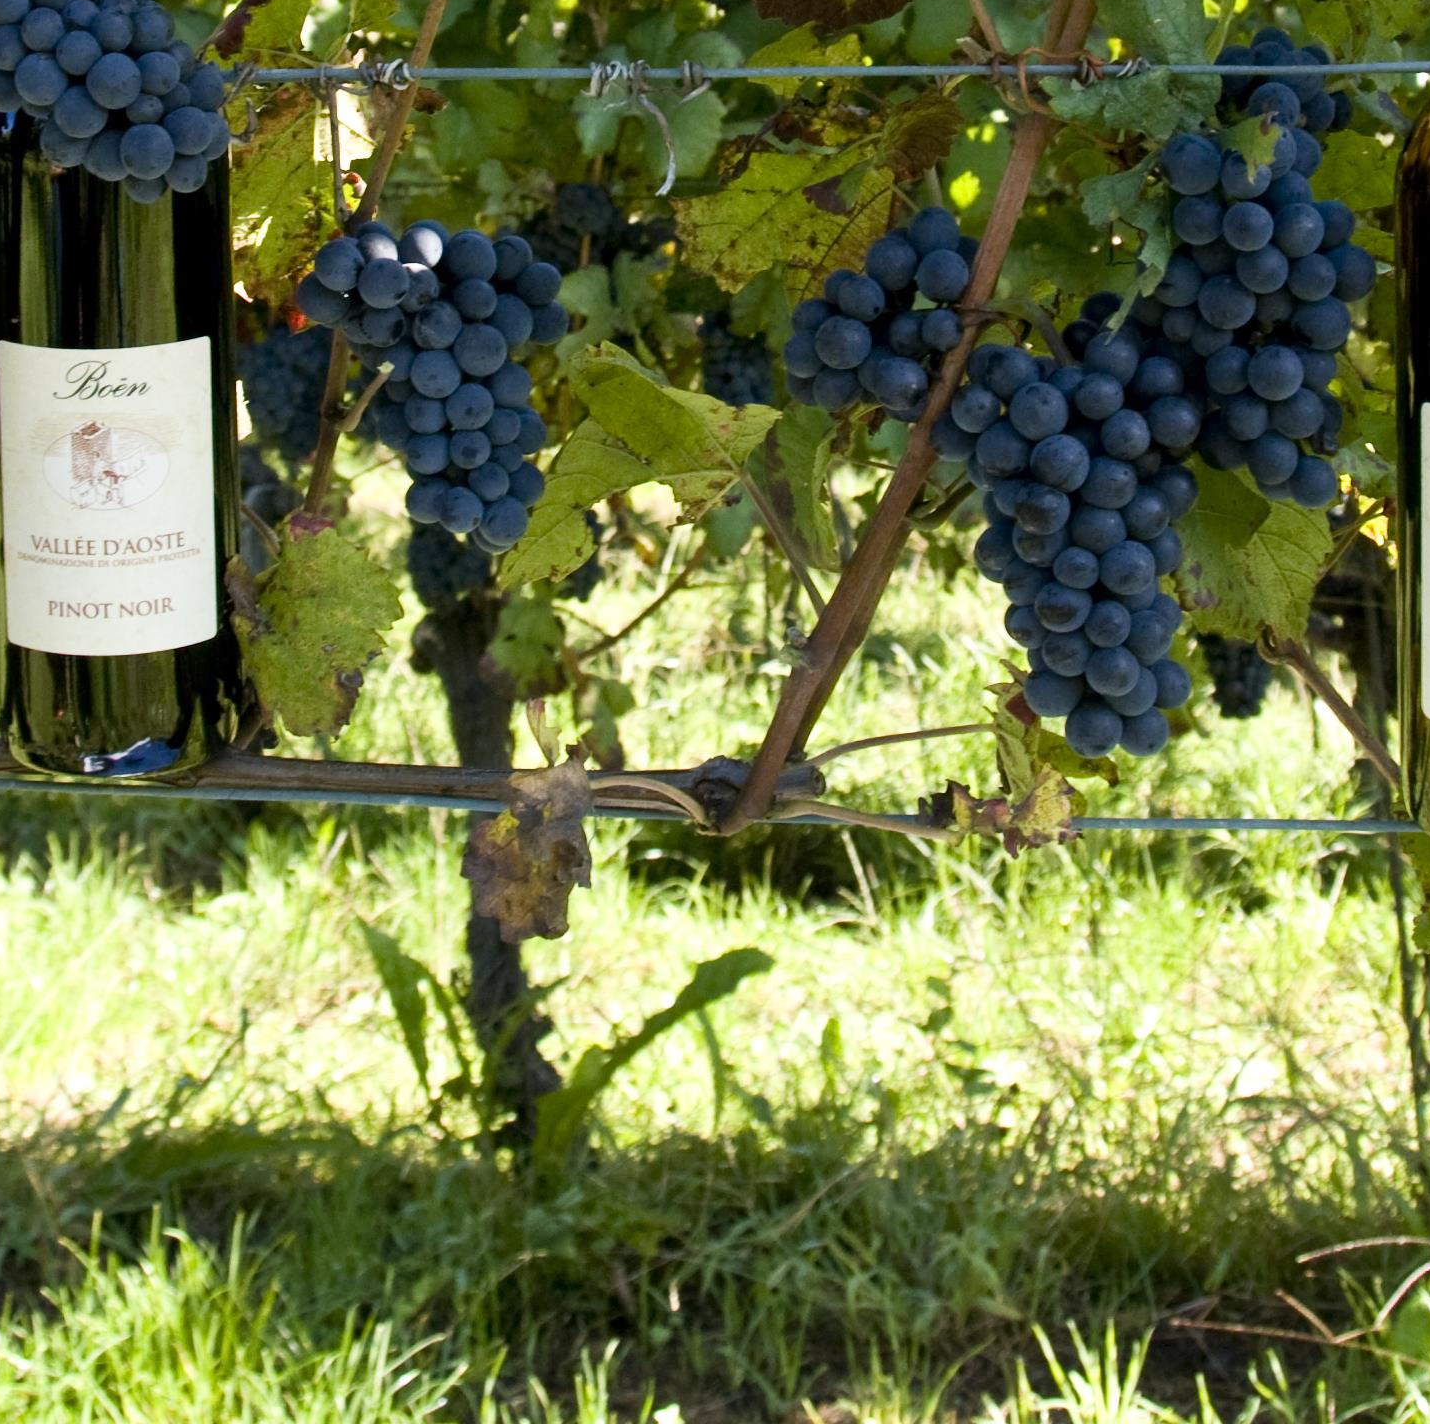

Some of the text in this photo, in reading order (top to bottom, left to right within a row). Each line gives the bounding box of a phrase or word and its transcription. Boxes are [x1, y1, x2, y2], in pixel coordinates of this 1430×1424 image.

[53, 360, 151, 400] Boën
[30, 531, 185, 556] VALLÉE D'AOSTE
[47, 597, 176, 619] PINOT NOIR
